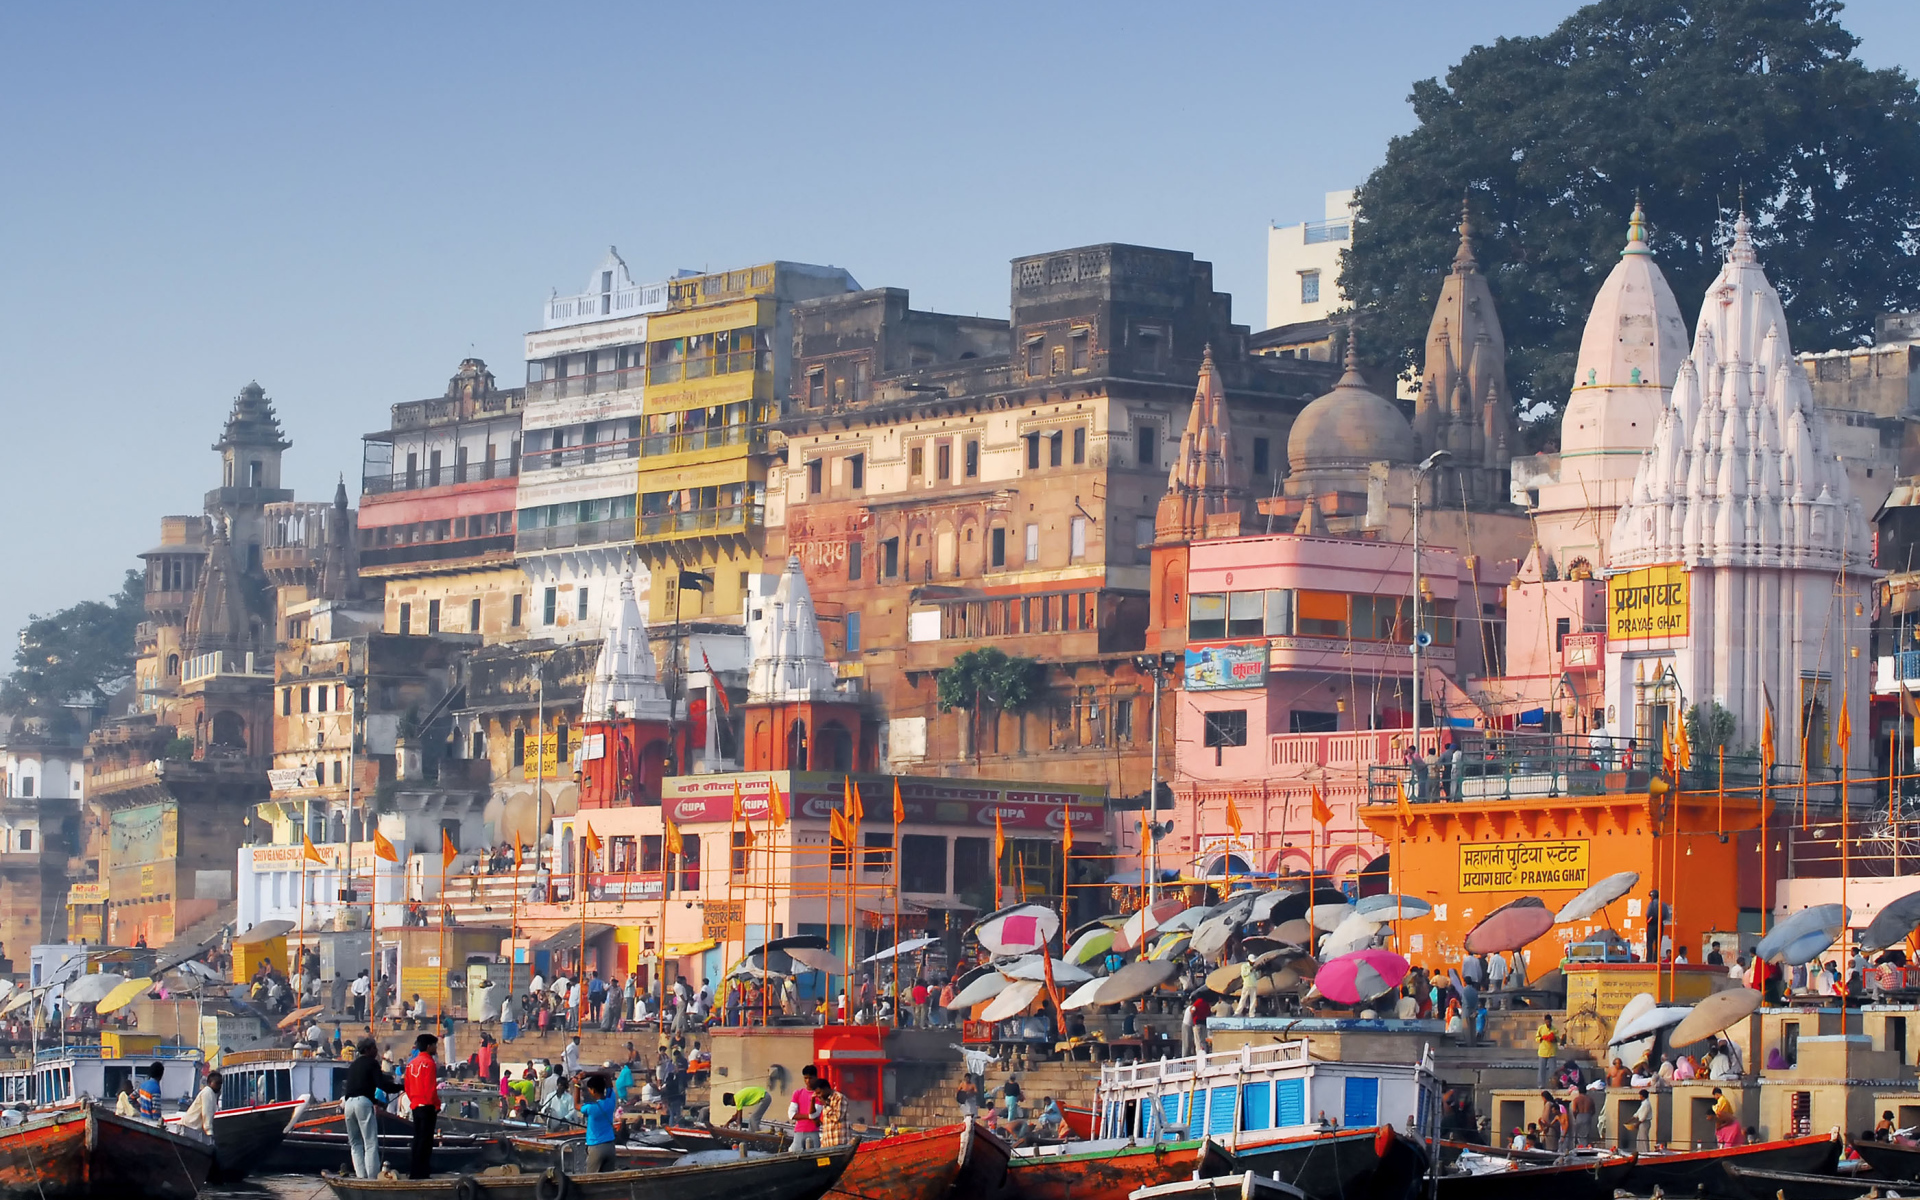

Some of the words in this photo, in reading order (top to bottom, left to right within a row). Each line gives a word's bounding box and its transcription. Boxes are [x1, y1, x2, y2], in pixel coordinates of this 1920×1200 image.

[1615, 586, 1656, 614] प्रयाग
[1657, 583, 1681, 606] घाट
[1617, 617, 1653, 633] PRAYAG
[1657, 615, 1681, 630] GHAT
[745, 781, 770, 789] मात
[681, 802, 706, 812] RUPA
[744, 800, 768, 810] RUPA
[814, 800, 844, 810] RUP
[988, 808, 1025, 819] RUPA
[287, 849, 303, 860] SILK
[1464, 845, 1504, 869] महारानी
[1506, 843, 1543, 870] पुटिया
[1547, 842, 1580, 864] स्टेट
[1463, 872, 1493, 887] प्रयाग
[1495, 872, 1512, 885] घाट
[1521, 870, 1560, 884] PRAYAG
[1562, 869, 1586, 882] GHAT
